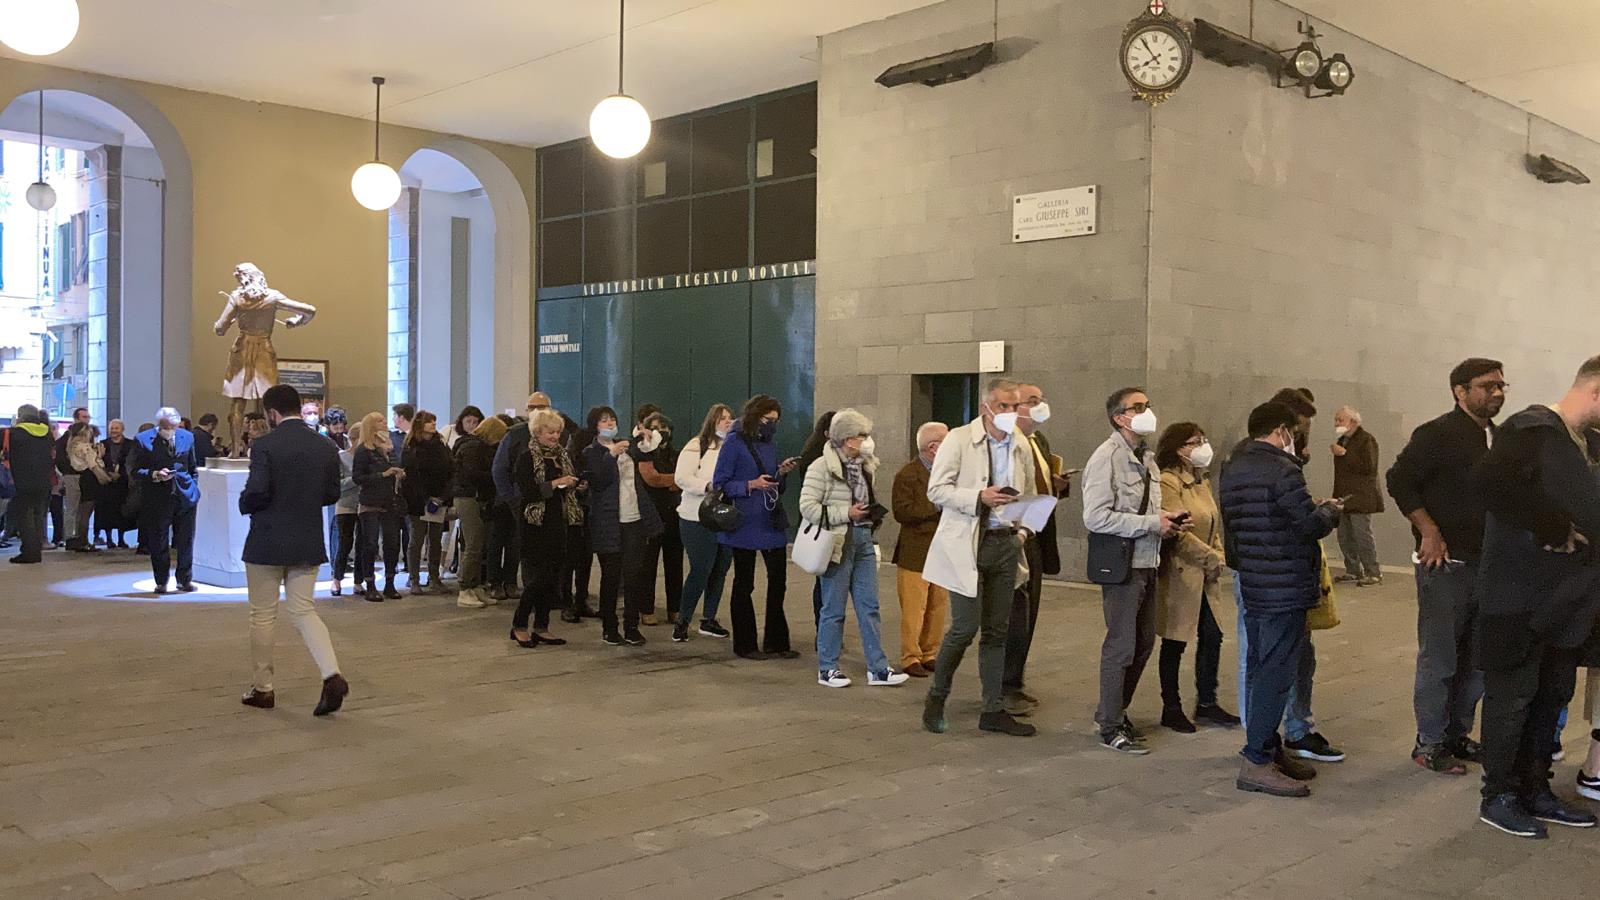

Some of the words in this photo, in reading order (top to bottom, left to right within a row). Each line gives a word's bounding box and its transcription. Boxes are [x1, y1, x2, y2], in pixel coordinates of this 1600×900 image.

[1037, 199, 1069, 208] GALLERIA
[1036, 208, 1069, 221] GIUSEPPE
[1075, 206, 1089, 217] SIRI
[583, 277, 664, 296] AUDITORIUM
[676, 270, 738, 288] EUGENIO
[748, 261, 810, 281] MONTAL
[540, 334, 569, 344] AUDITORIUM
